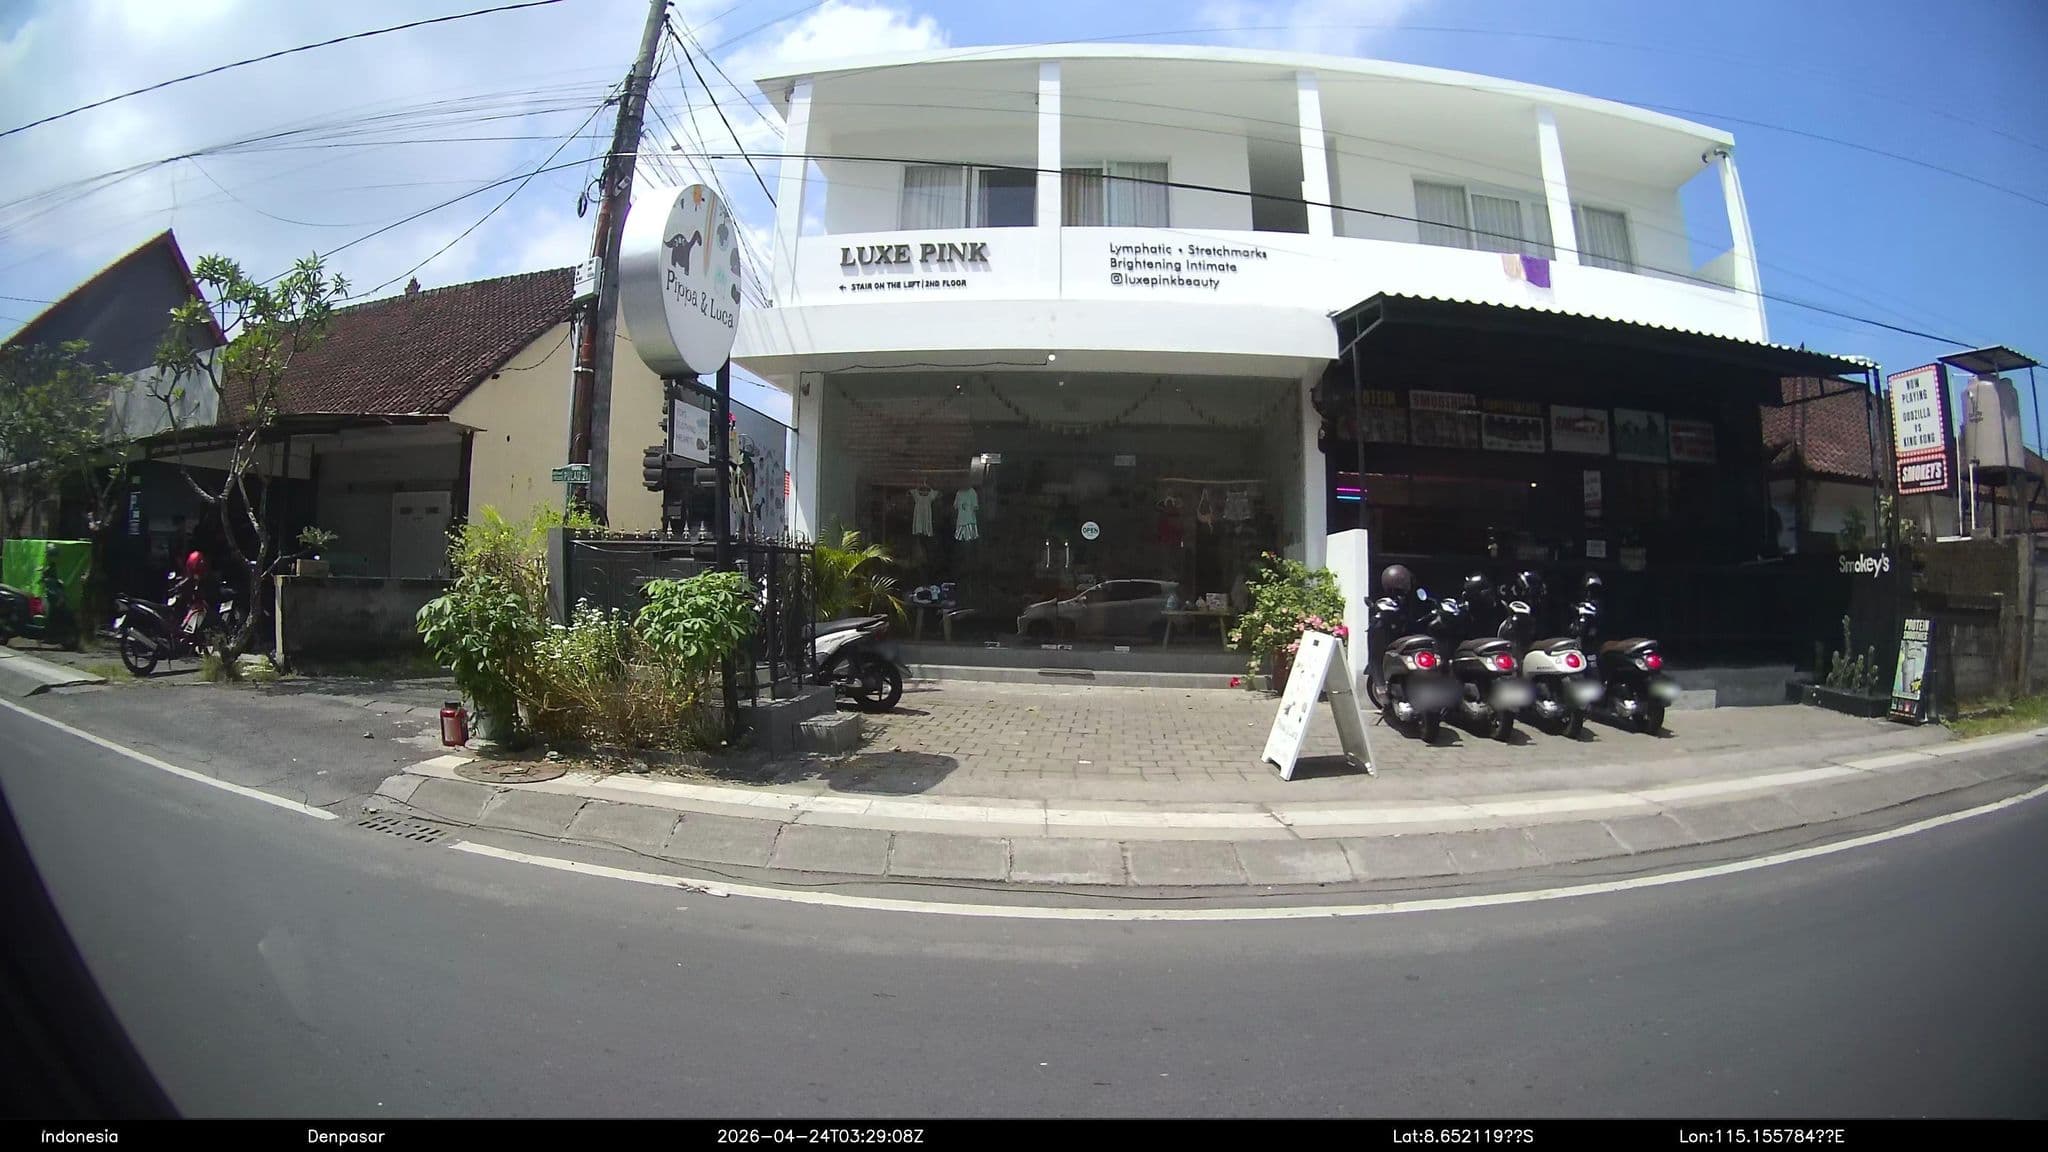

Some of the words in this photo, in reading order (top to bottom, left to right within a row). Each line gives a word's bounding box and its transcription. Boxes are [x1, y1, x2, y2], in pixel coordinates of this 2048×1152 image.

[840, 244, 911, 266] LUXE
[919, 242, 988, 263] PINK
[1110, 242, 1172, 256] Lymphatic
[1188, 244, 1268, 259] Stretchmarks
[1110, 257, 1182, 272] Brightening
[1186, 259, 1238, 272] Intimate
[851, 283, 873, 291] STAIR
[874, 281, 885, 290] ON
[887, 281, 901, 289] THE
[903, 280, 920, 289] LEFT
[925, 280, 940, 288] 2ND
[942, 279, 967, 288] FLOOR
[1125, 273, 1220, 290] luxepinkbeauty
[666, 268, 698, 307] Pippa
[700, 291, 708, 316] &
[710, 298, 734, 328] Luca
[1906, 378, 1920, 390] NOW
[1901, 389, 1928, 404] PLAYING
[1902, 407, 1931, 422] GODZILLA
[1903, 435, 1918, 448] KING
[1920, 432, 1936, 445] KONG
[1839, 552, 1890, 578] Smokey's
